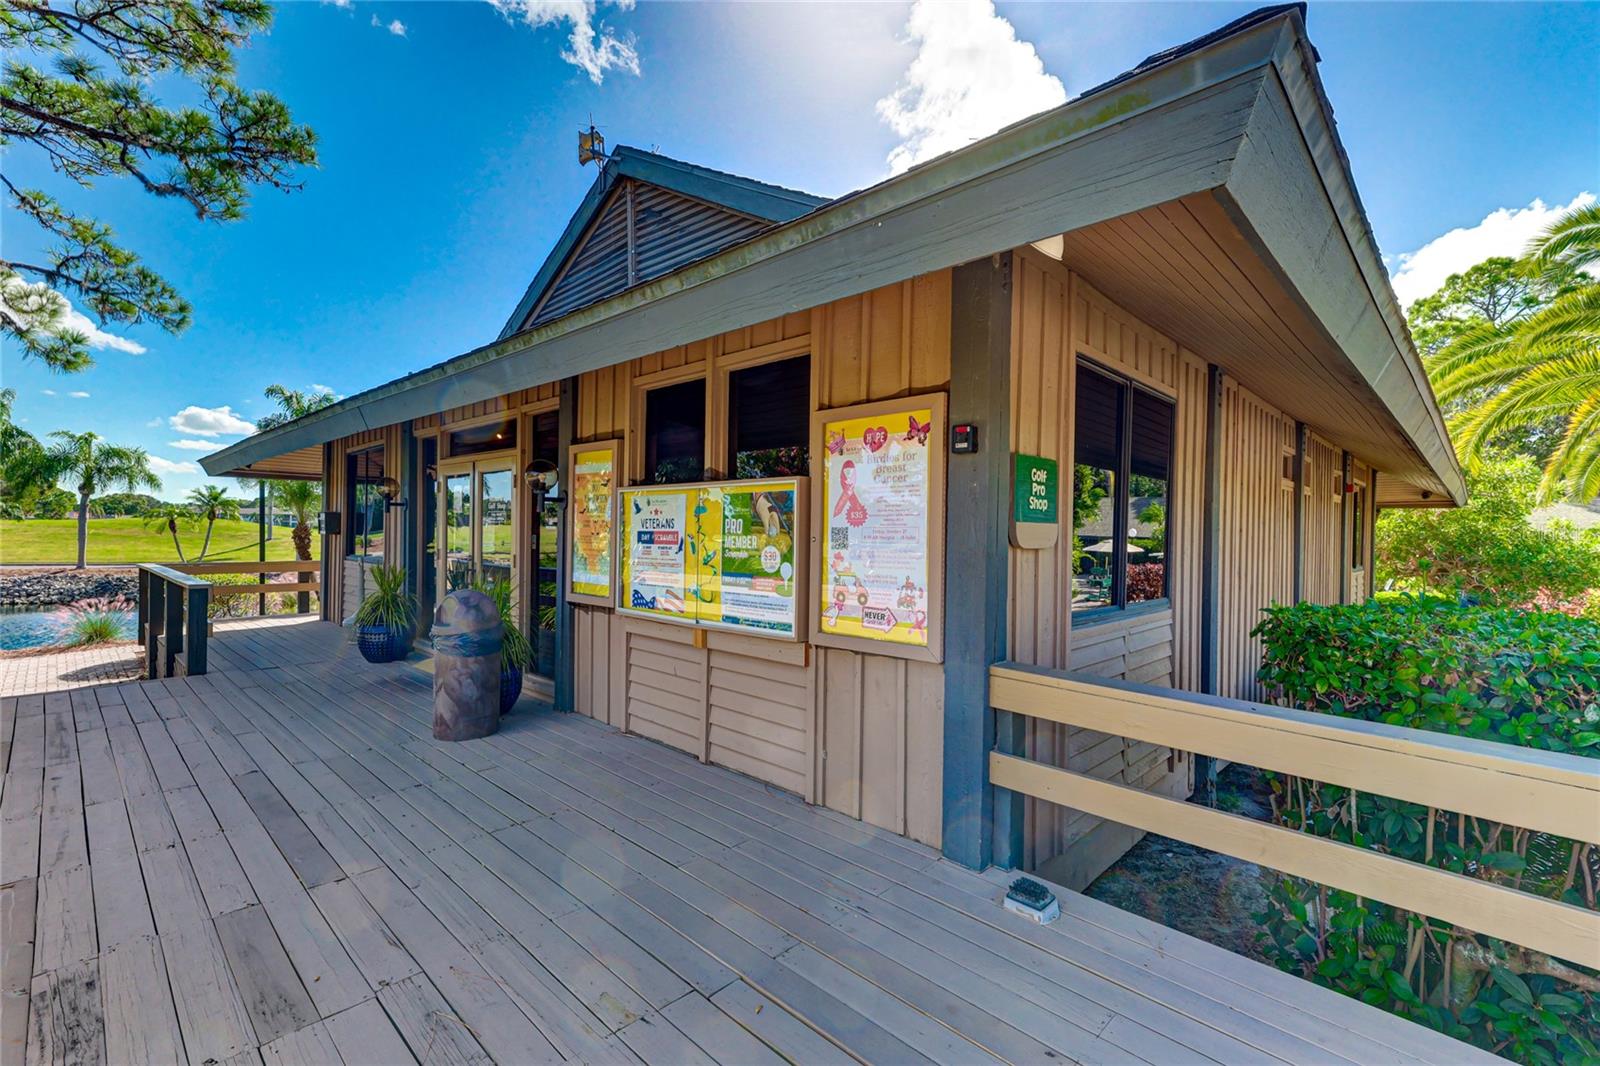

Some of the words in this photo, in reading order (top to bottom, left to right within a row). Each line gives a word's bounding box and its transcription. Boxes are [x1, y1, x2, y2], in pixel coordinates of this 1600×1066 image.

[902, 450, 917, 462] for
[1031, 468, 1048, 483] Golf
[1032, 483, 1046, 496] Pro
[1029, 496, 1048, 512] Shop
[640, 518, 675, 529] VETERANS
[725, 518, 743, 534] PRO
[725, 535, 757, 549] MEMBER
[864, 611, 886, 621] NEVER
